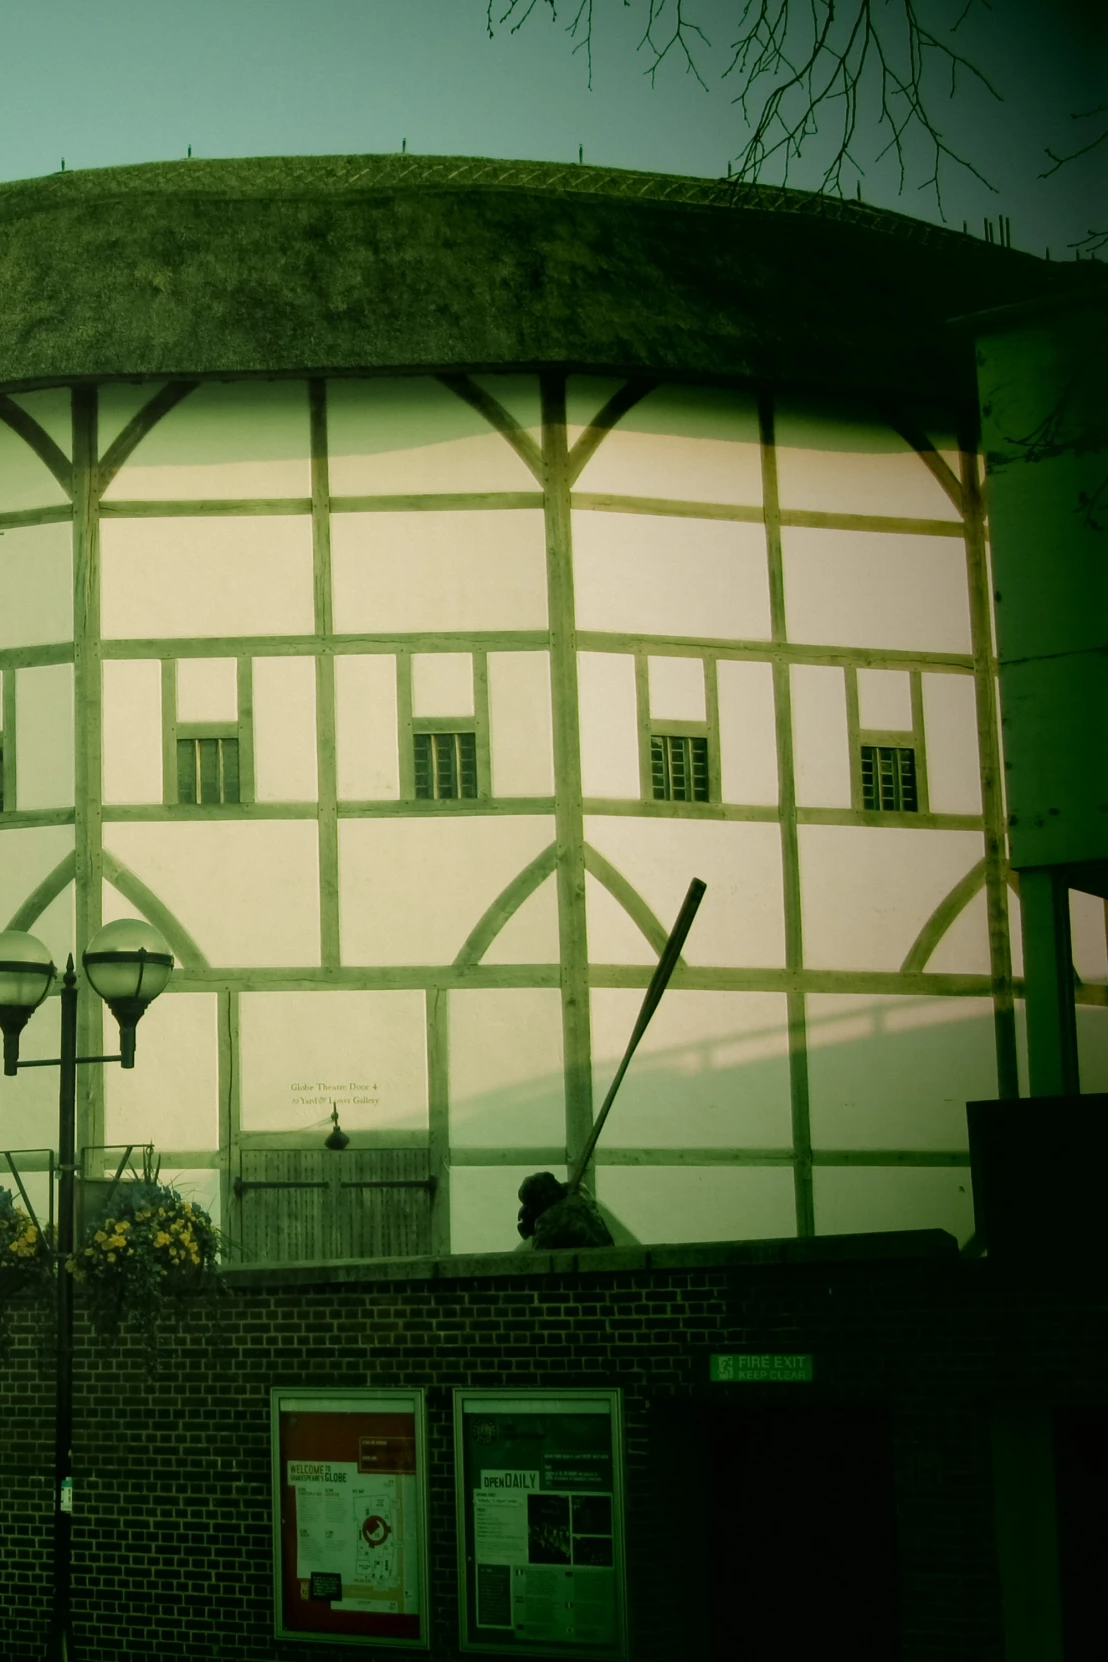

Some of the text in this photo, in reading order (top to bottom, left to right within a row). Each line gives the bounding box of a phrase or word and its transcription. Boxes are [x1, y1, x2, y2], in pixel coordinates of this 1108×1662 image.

[291, 1083, 314, 1091] Globe
[317, 1083, 346, 1091] Theatre
[349, 1083, 370, 1091] Door
[353, 1097, 379, 1106] Gallery
[738, 1355, 806, 1368] FIRE EXIT
[738, 1370, 806, 1380] KEEP CLEAR
[290, 1464, 324, 1474] WELCOME
[325, 1472, 347, 1483] GLOBE
